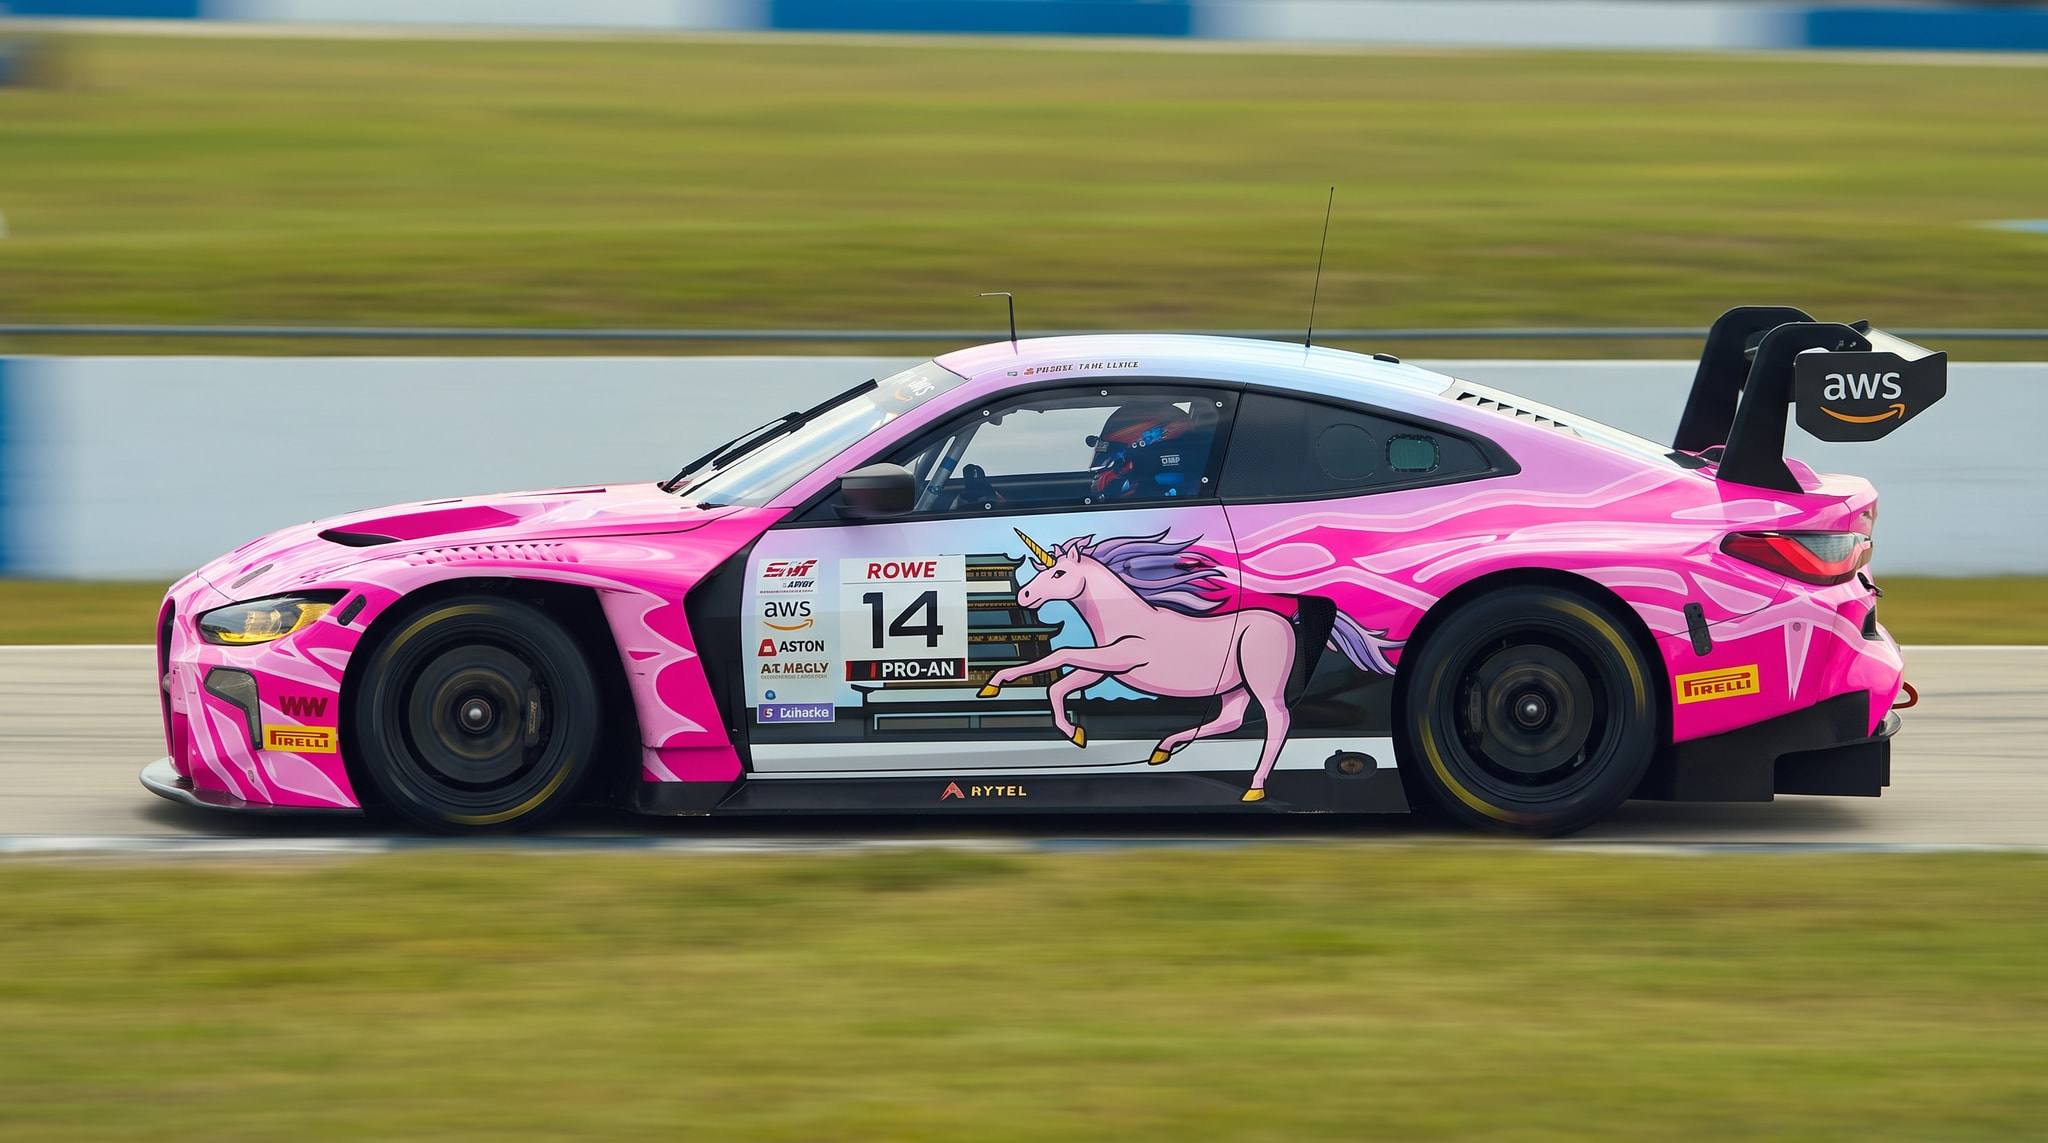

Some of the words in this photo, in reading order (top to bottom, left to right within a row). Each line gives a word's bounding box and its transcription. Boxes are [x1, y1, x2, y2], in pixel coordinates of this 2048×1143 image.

[1823, 372, 1902, 400] aws
[867, 561, 937, 579] ROWE
[764, 600, 811, 618] aws
[863, 590, 943, 649] 14
[779, 640, 825, 652] ASTON
[882, 661, 955, 677] PRO-AN
[1683, 672, 1751, 697] PIRELLI
[270, 730, 329, 748] PIRELLI
[971, 785, 1027, 797] RYTEL
